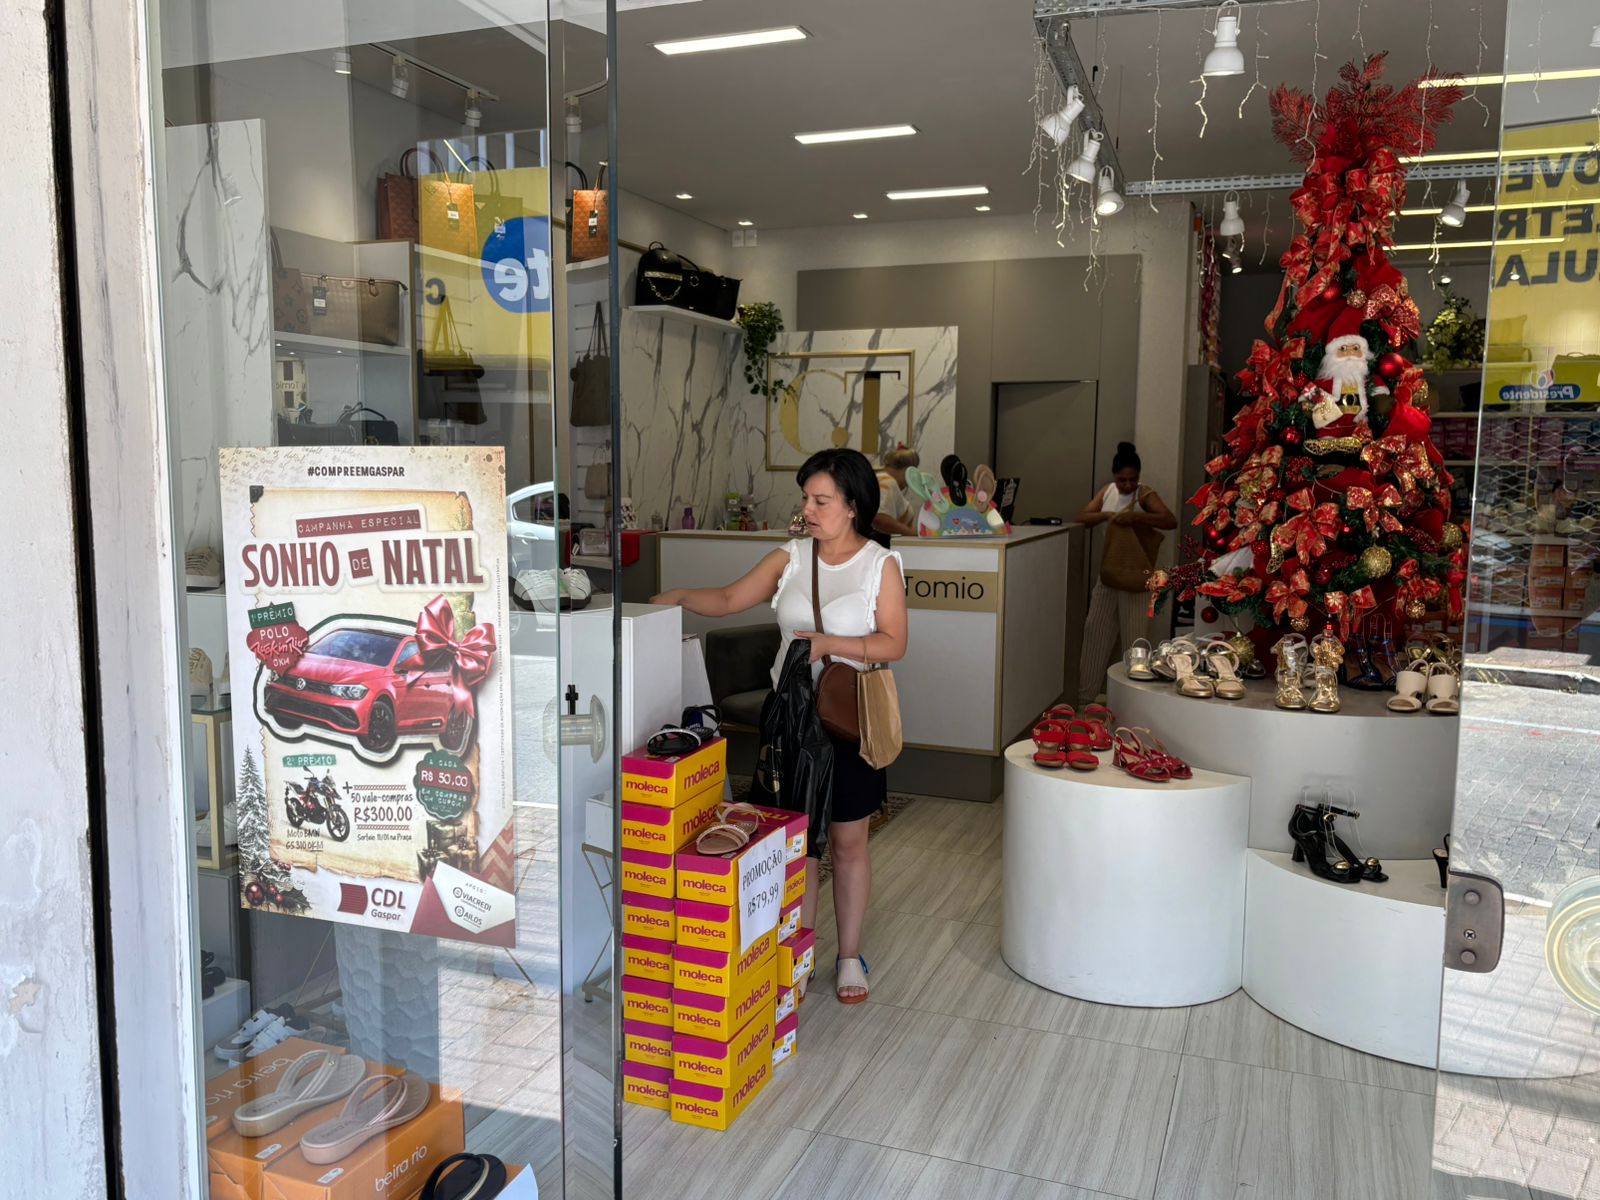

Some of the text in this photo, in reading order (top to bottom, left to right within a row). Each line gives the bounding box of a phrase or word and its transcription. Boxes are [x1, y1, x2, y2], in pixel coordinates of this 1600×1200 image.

[307, 465, 405, 478] #COMPREEMGASPAR
[298, 516, 420, 535] CAMPANHA ESPECIAL
[242, 538, 483, 588] SONHO DE NATAL
[905, 576, 984, 600] Tomio
[260, 626, 289, 640] POLO
[684, 760, 720, 790] moleca
[625, 779, 668, 795] moleca
[351, 792, 414, 805] 50 vale-compras
[623, 827, 666, 842] moleca
[625, 868, 667, 886] moleca
[742, 849, 783, 891] PROMOÇÃO
[682, 878, 727, 893] moleca
[371, 887, 406, 910] CDL
[463, 893, 491, 911] VIACREDI
[371, 909, 401, 921] Gaspar
[627, 912, 670, 928] moleca
[682, 923, 726, 939] moleca
[628, 955, 670, 971] moleca
[737, 936, 770, 977] moleca
[679, 968, 723, 984] moleca
[627, 998, 669, 1014] moleca
[736, 979, 771, 1020] moleca
[678, 1012, 721, 1028] moleca
[629, 1040, 672, 1057] moleca
[737, 1022, 769, 1066] moleca
[679, 1059, 723, 1076] moleca
[628, 1082, 670, 1099] moleca
[733, 1063, 767, 1108] moleca
[675, 1101, 719, 1118] moleca
[375, 1158, 409, 1192] beira
[411, 1145, 427, 1166] rio
